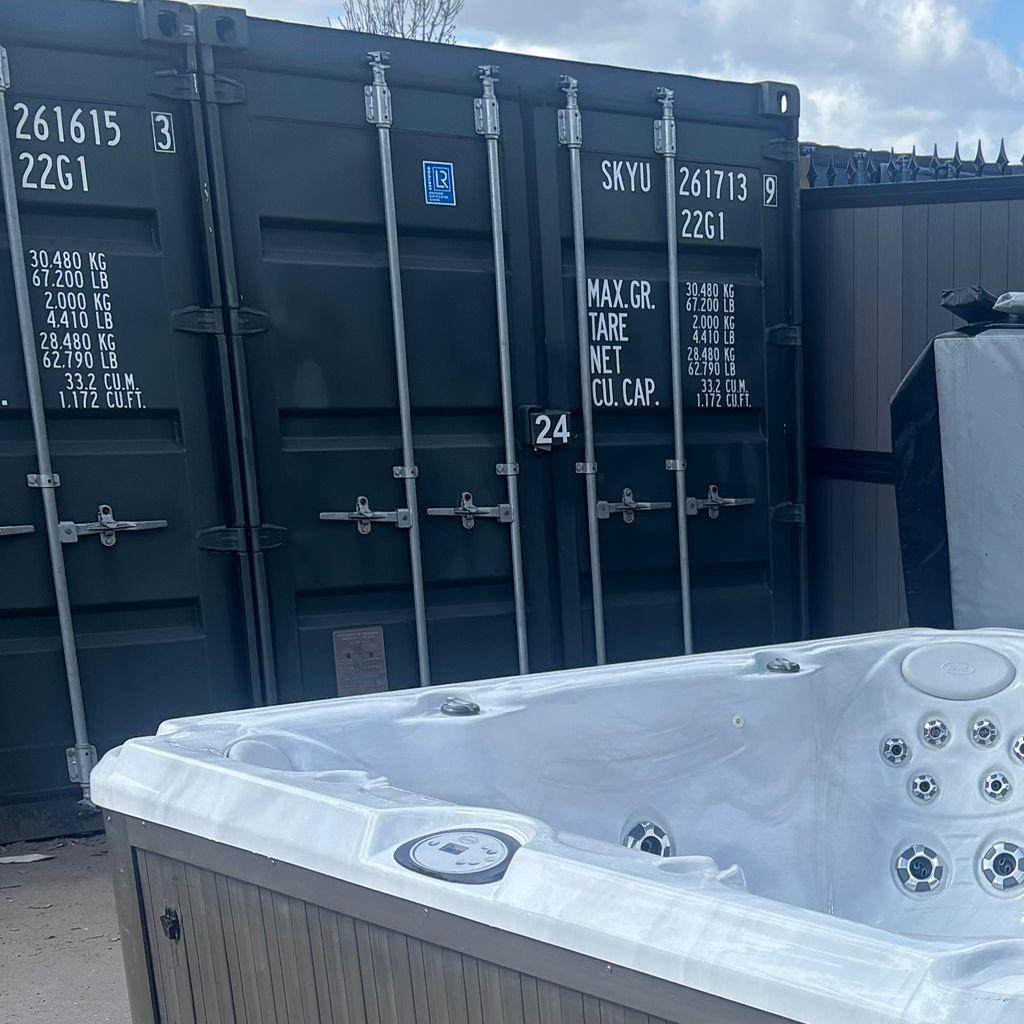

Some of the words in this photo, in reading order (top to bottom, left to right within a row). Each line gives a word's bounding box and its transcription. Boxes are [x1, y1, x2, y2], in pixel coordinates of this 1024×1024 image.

[14, 103, 120, 146] 261615
[156, 116, 172, 151] 3
[19, 152, 88, 191] 22G1
[602, 160, 650, 192] SKYU
[680, 167, 747, 201] 261713
[766, 177, 775, 203] 9
[682, 209, 723, 240] 22G1
[89, 252, 106, 272] KG
[91, 272, 108, 289] LB
[724, 284, 734, 298] KG
[94, 293, 111, 310] KG
[724, 299, 734, 312] LB
[96, 312, 113, 329] LB
[589, 312, 628, 341] TARE
[724, 316, 734, 329] KG
[98, 333, 115, 353] KG
[724, 331, 734, 344] LB
[101, 352, 117, 368] LB
[590, 345, 621, 374] NET
[724, 348, 734, 363] KG
[725, 363, 735, 376] LB
[65, 373, 96, 392] 33.2
[701, 379, 720, 395] 33.2
[536, 414, 570, 443] 24
